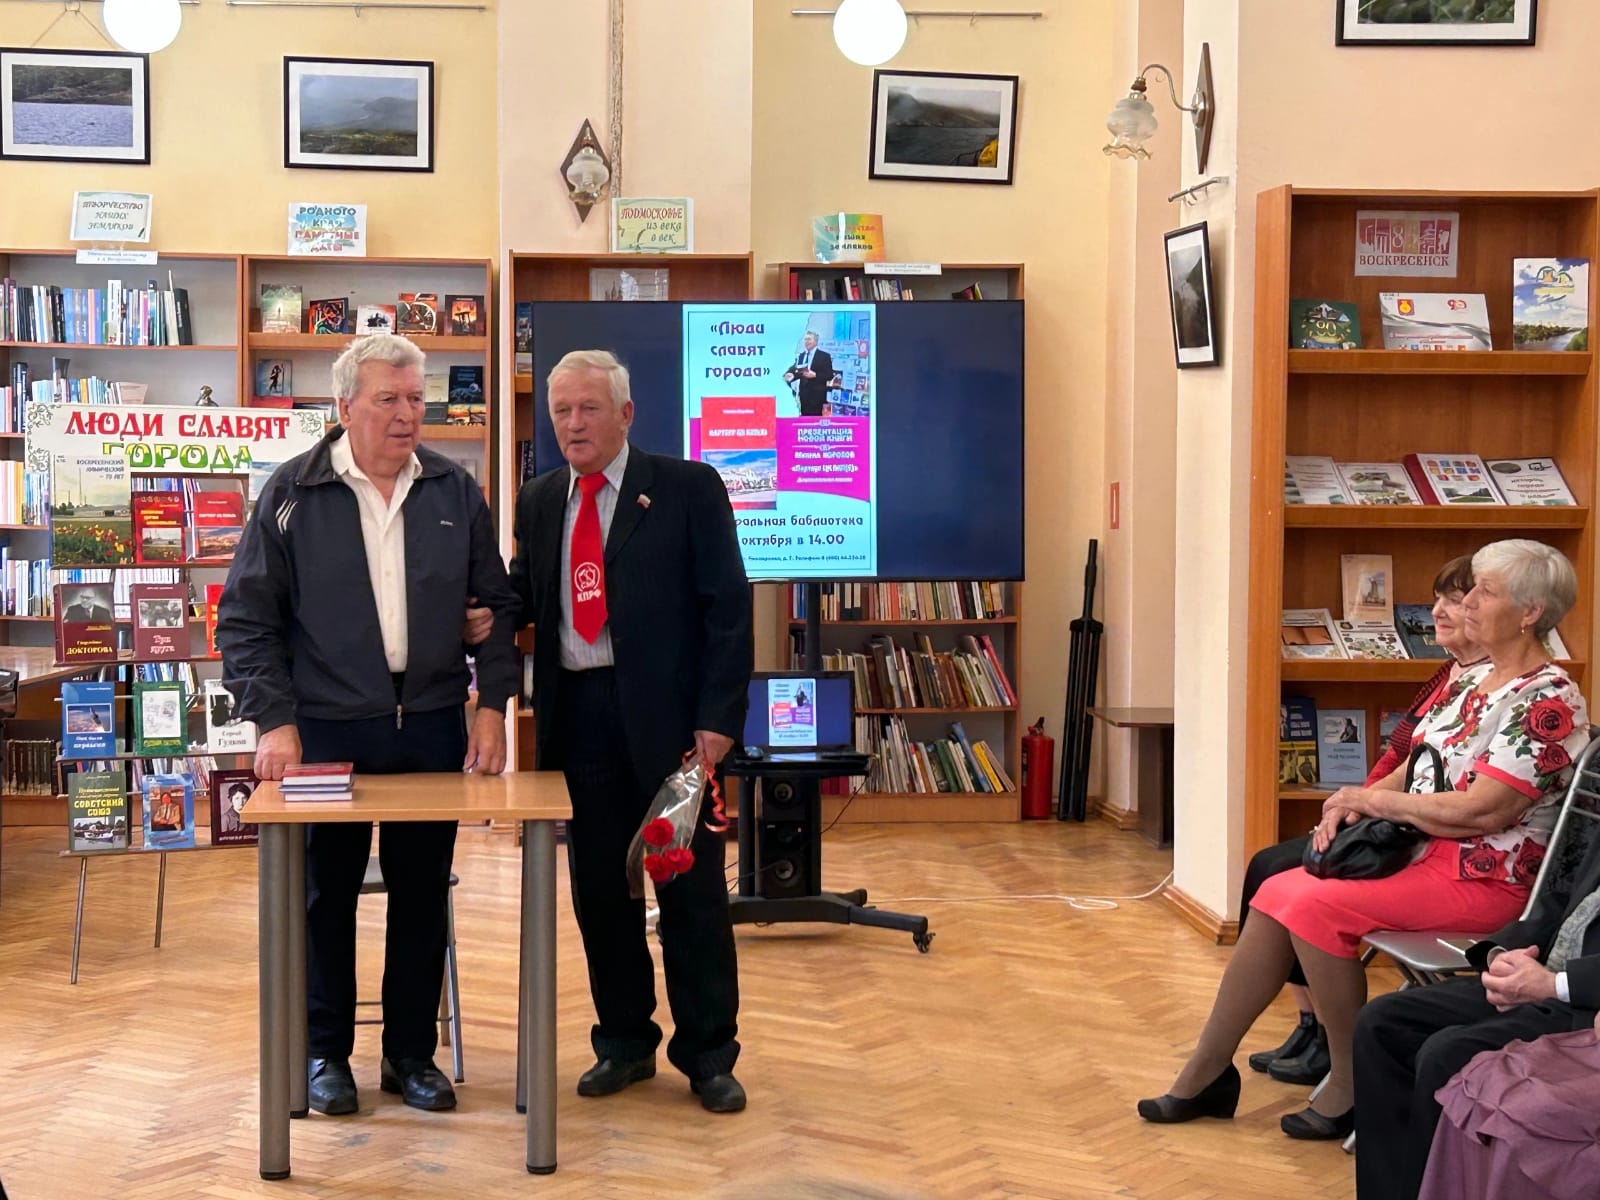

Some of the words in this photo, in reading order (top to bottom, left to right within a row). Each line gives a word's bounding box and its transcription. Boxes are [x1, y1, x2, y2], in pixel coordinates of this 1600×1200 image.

[299, 205, 357, 217] РОДНОГО
[620, 207, 683, 220] ПОДМОСКОВЬЕ
[1359, 254, 1450, 267] ВОСКРЕСЕНСК
[710, 321, 765, 336] «Люди
[710, 345, 766, 357] славят
[705, 367, 770, 380] города»
[64, 411, 163, 441] ЛЮДИ
[178, 413, 290, 442] СЛАВЯТ
[102, 442, 251, 473] ГОРОДА
[736, 518, 786, 527] ральная
[790, 515, 864, 527] библиотека
[741, 534, 792, 548] октября
[796, 537, 804, 545] в
[808, 534, 845, 545] 14.00
[577, 589, 602, 603] КПРФ
[66, 646, 113, 656] ДОКТОРОВА
[74, 797, 124, 809] СОВЕТСКИЙ
[87, 807, 111, 816] СОЮЗ
